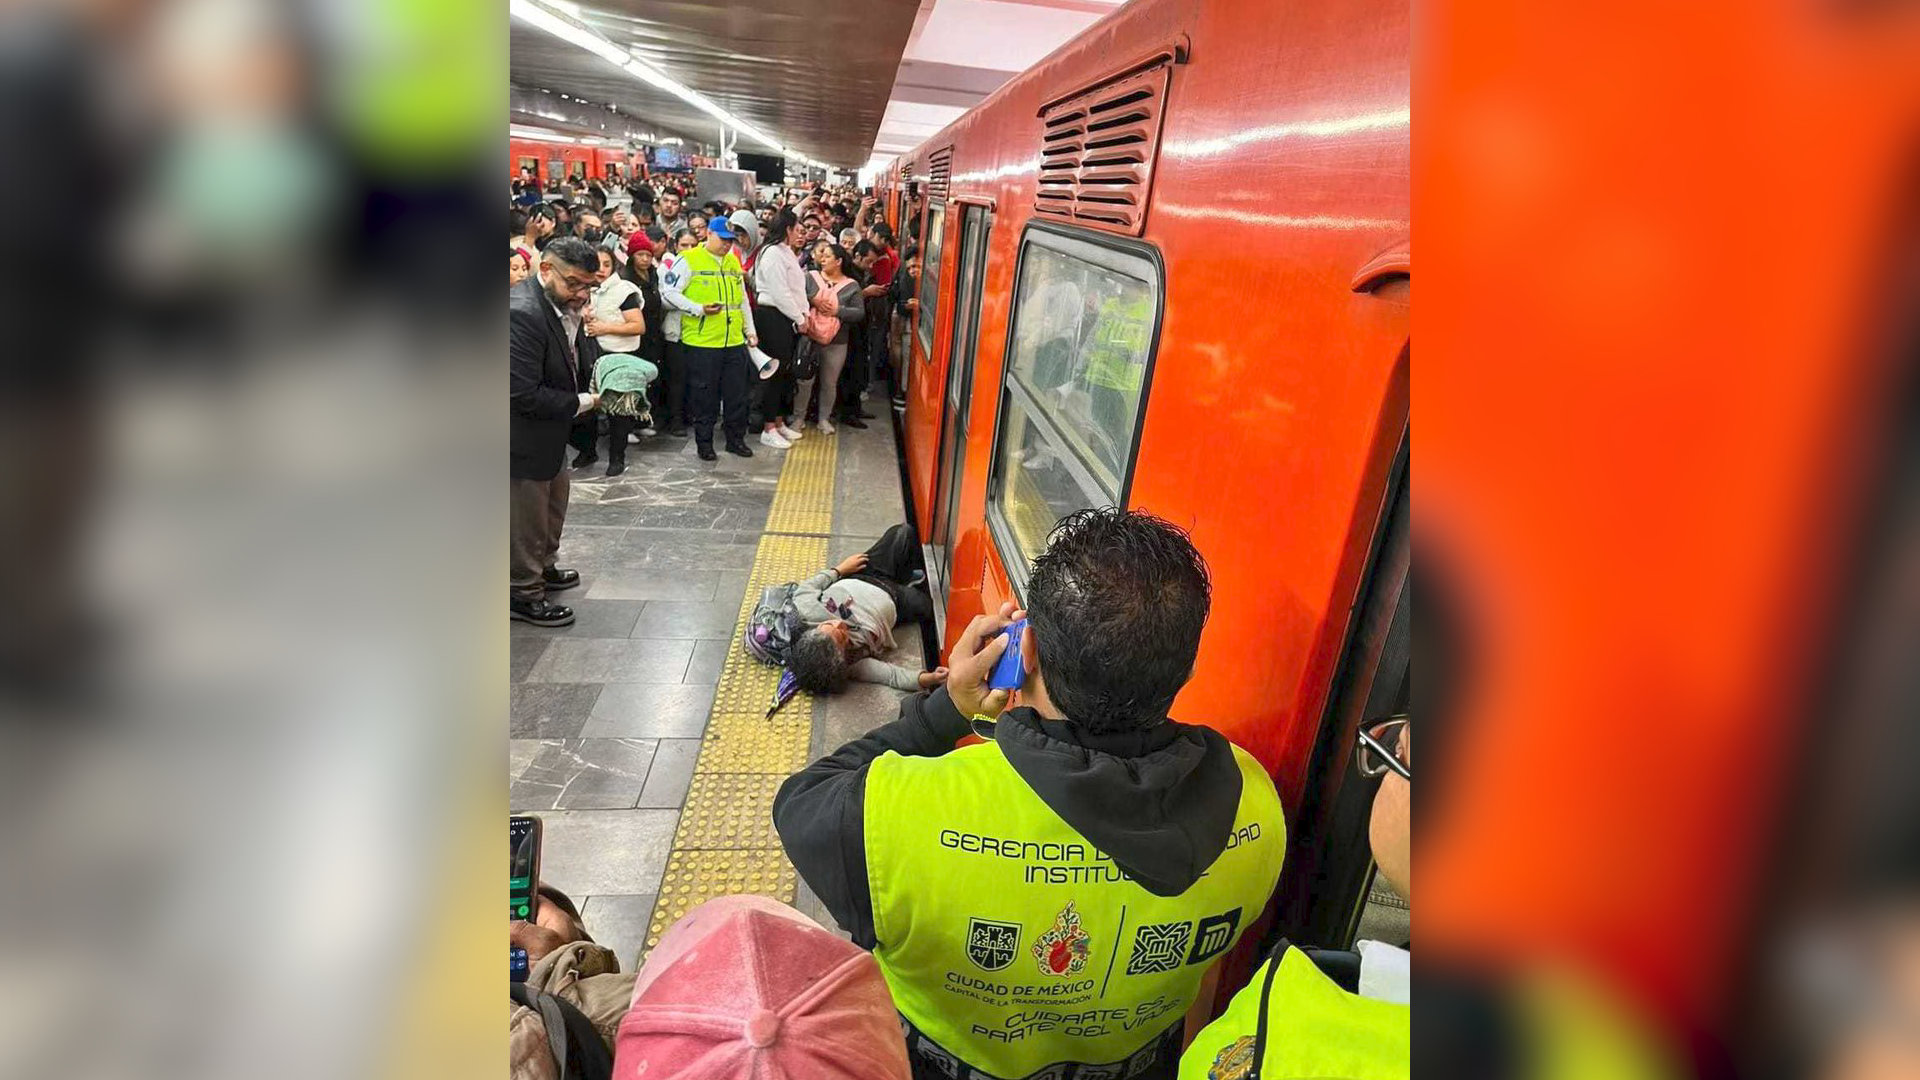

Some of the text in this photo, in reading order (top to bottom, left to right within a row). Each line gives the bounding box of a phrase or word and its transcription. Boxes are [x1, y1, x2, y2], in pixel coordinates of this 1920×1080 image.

[940, 829, 1085, 862] GERENCIA
[944, 983, 981, 1000] CAPITAL
[983, 995, 995, 1004] DE
[1011, 994, 1092, 1006] TRANSFORMACIÓN
[946, 971, 1095, 996] CIUDAD DE MÉXICO
[971, 998, 1181, 1044] PARTE DEL VIAJE
[1005, 995, 1166, 1029] CUIDARTE ES
